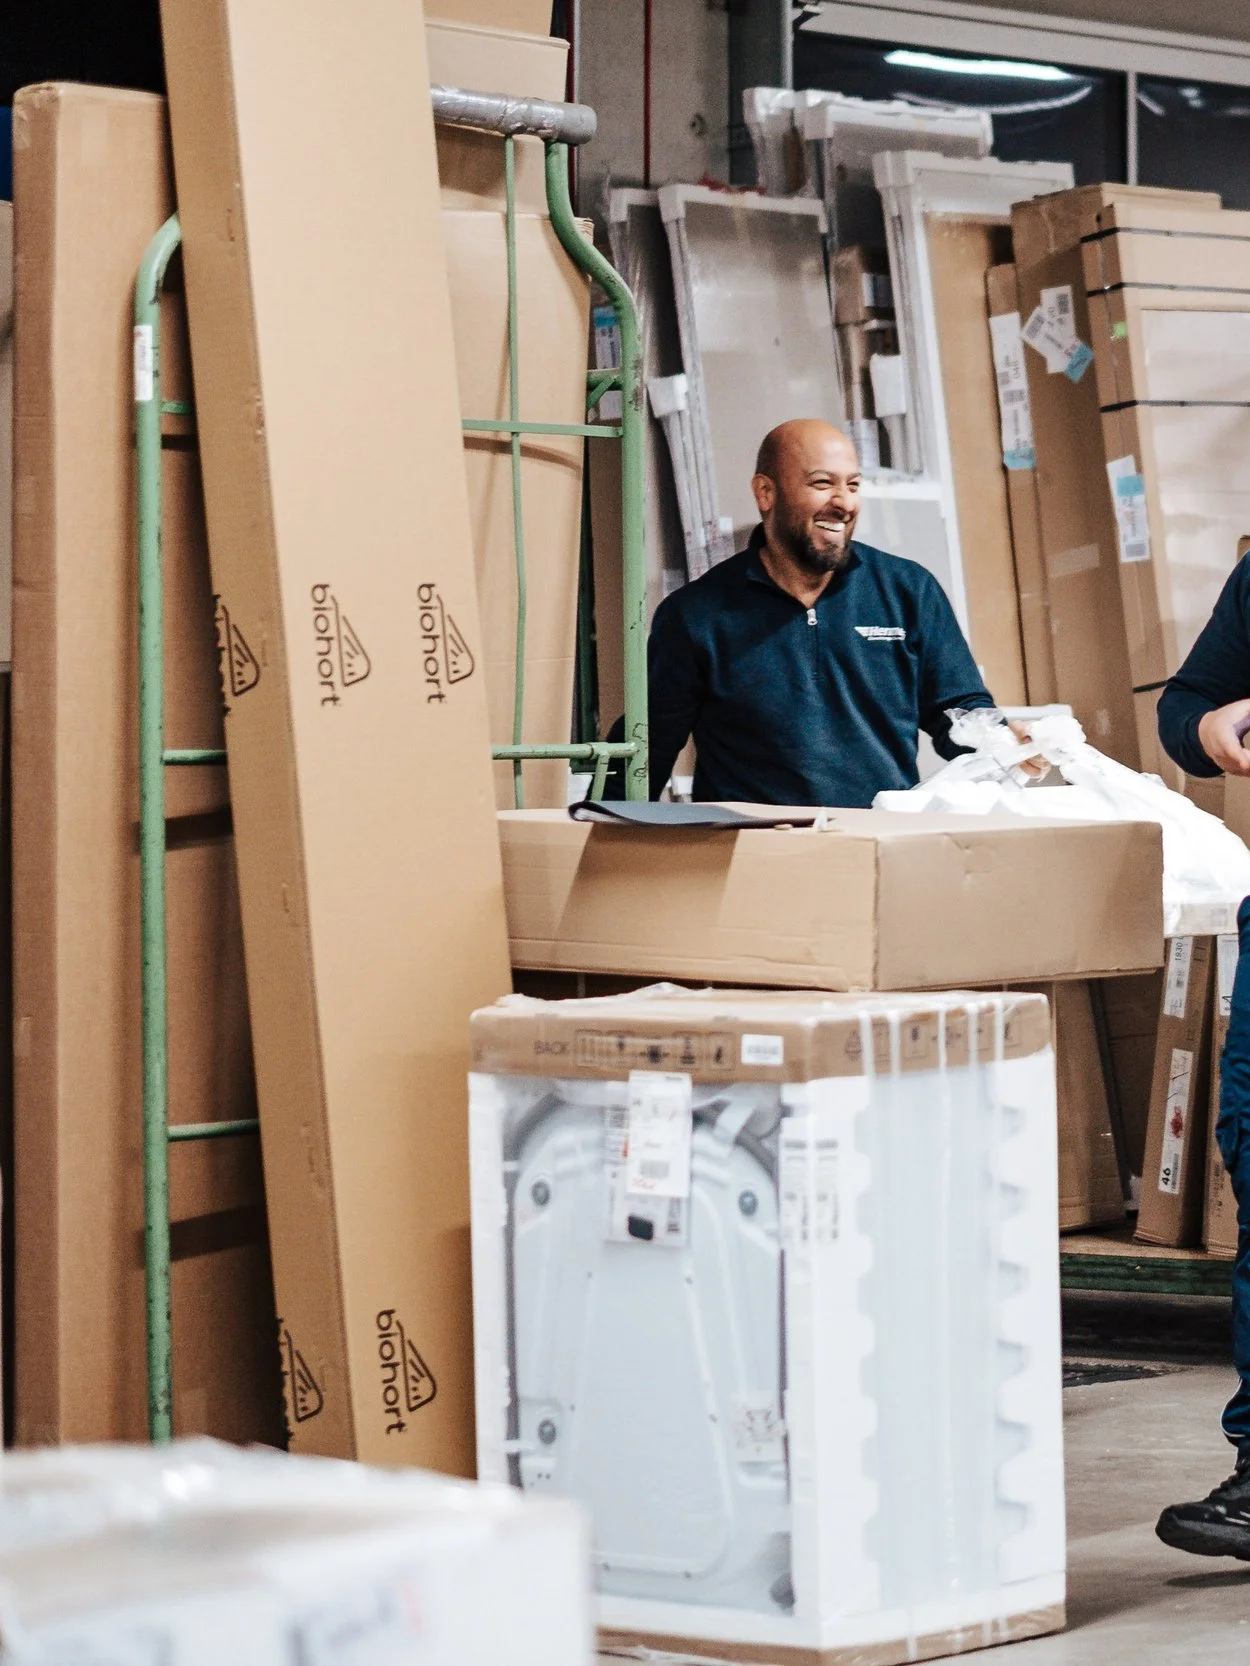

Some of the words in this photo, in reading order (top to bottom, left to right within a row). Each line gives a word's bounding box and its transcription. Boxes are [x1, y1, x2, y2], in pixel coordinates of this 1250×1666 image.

[311, 583, 341, 707] biohort
[417, 583, 446, 704] biohort
[1161, 1167, 1171, 1186] 46
[376, 1308, 407, 1435] biohort
